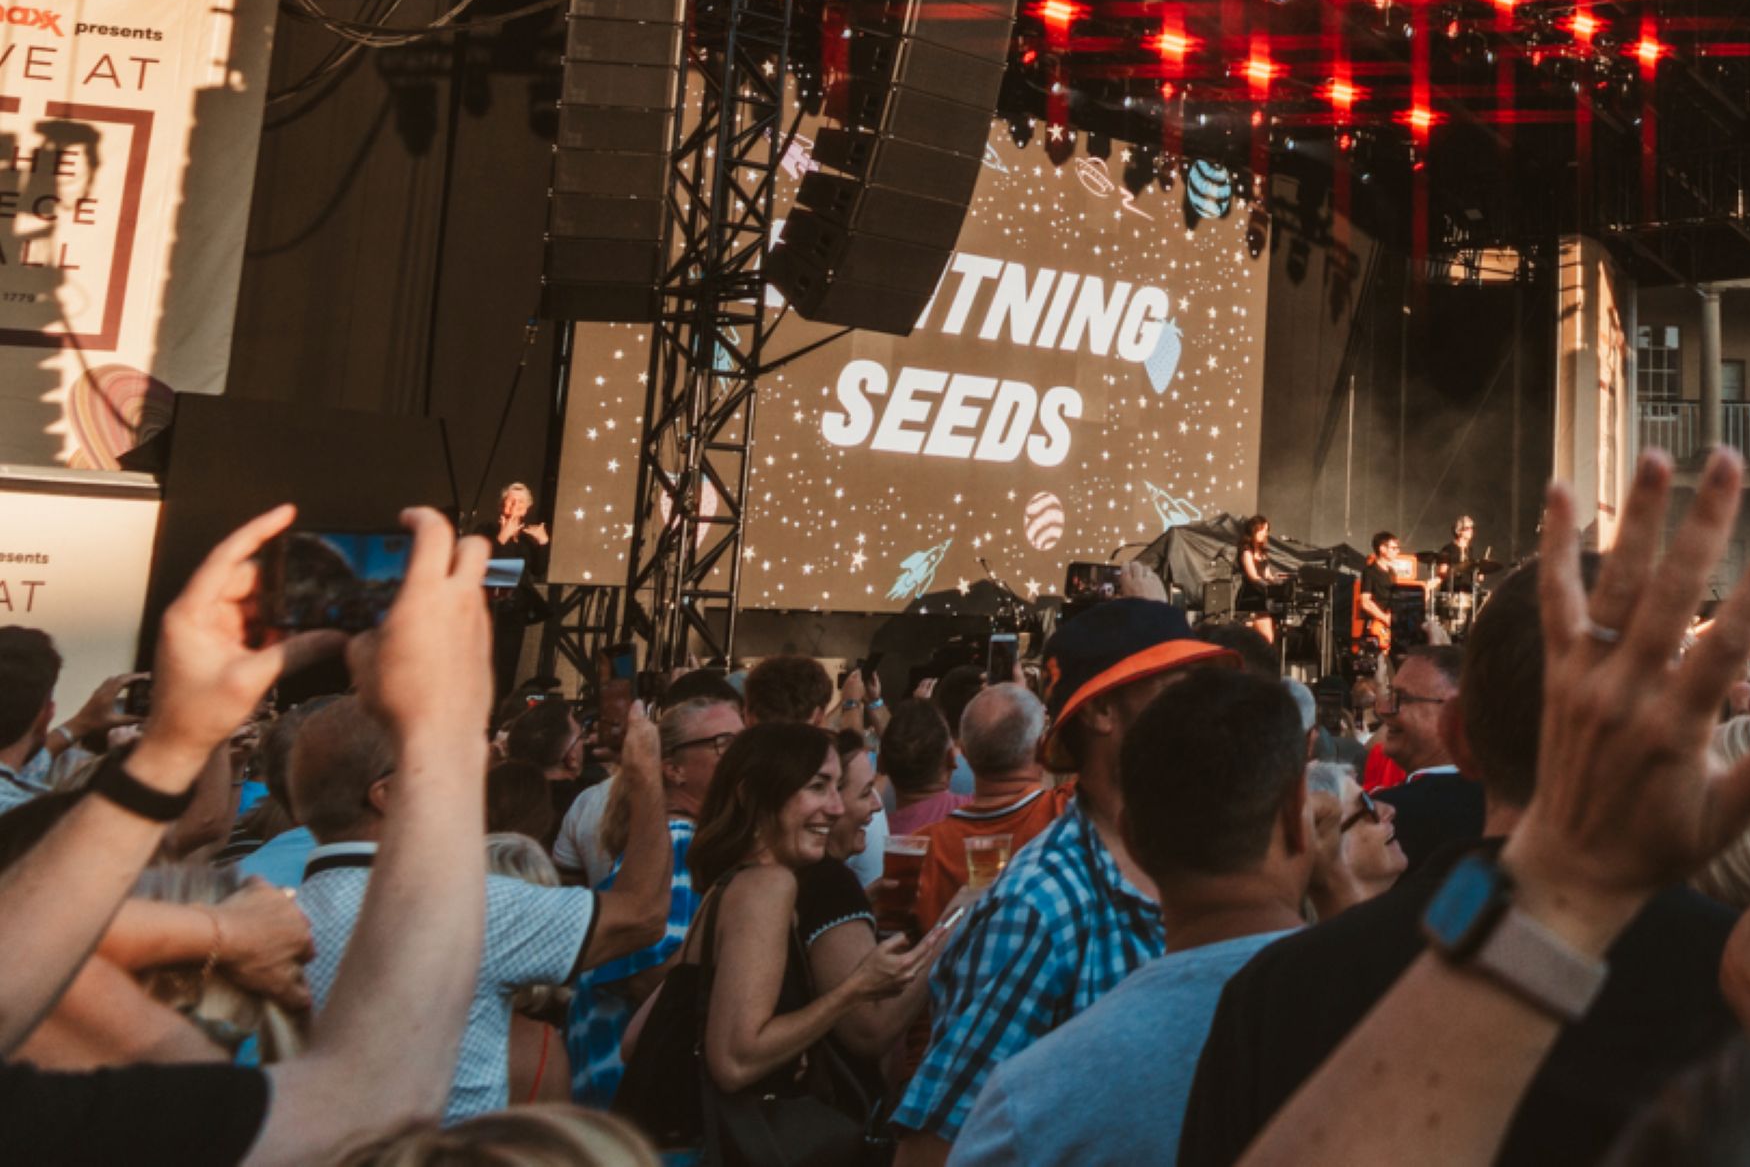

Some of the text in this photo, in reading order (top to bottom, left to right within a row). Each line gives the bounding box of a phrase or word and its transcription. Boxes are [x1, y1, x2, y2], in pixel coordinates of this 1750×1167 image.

[74, 22, 164, 42] presents
[82, 53, 161, 91] AT
[822, 359, 1083, 468] SEEDS
